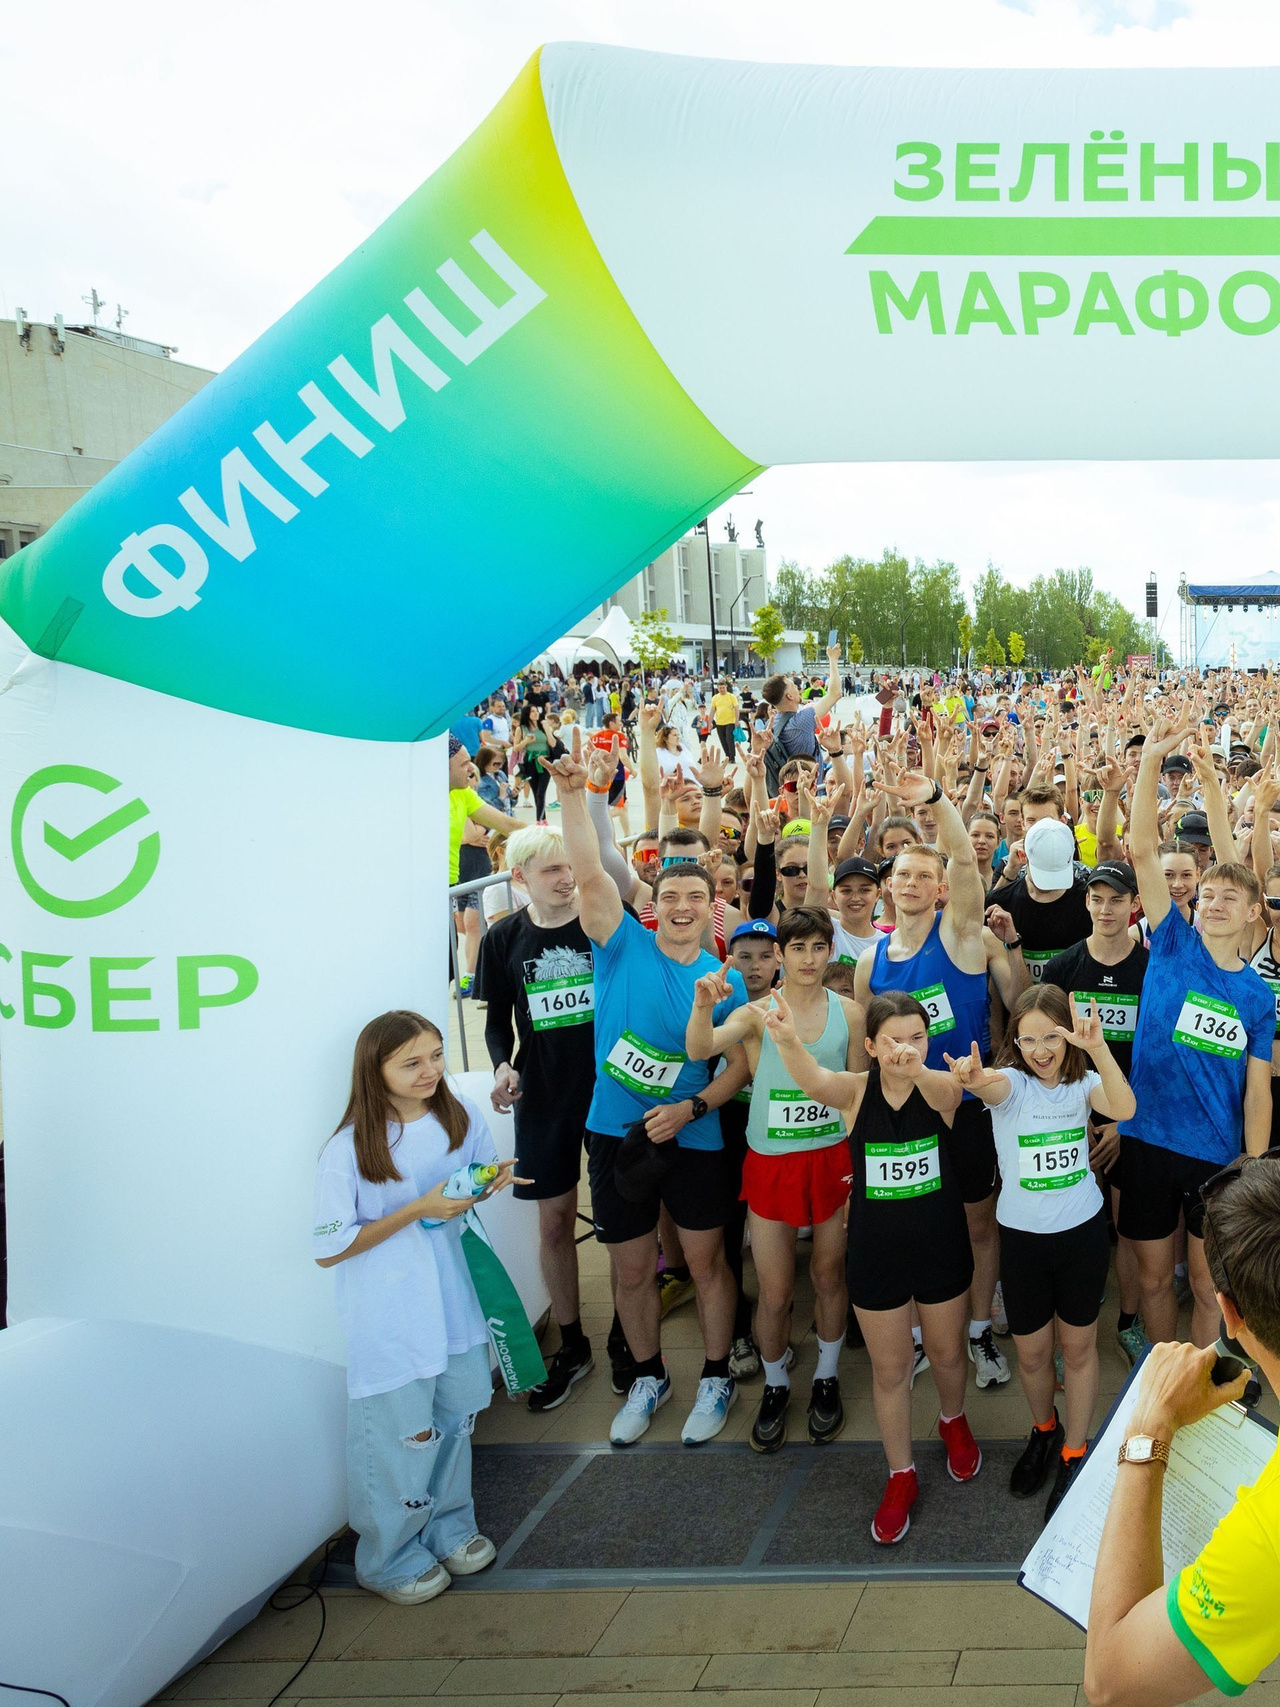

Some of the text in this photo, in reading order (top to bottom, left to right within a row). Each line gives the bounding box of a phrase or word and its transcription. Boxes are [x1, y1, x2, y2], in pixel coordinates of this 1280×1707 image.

[101, 228, 548, 618] ФИНИШ
[0, 942, 259, 1032] БЕР
[541, 990, 591, 1012] 1604
[1194, 1013, 1238, 1042] 1366
[624, 1052, 668, 1081] 1061
[783, 1105, 830, 1122] 1284
[880, 1156, 930, 1180] 1595
[1032, 1148, 1078, 1172] 1559
[497, 1340, 520, 1390] МАРАФОН
